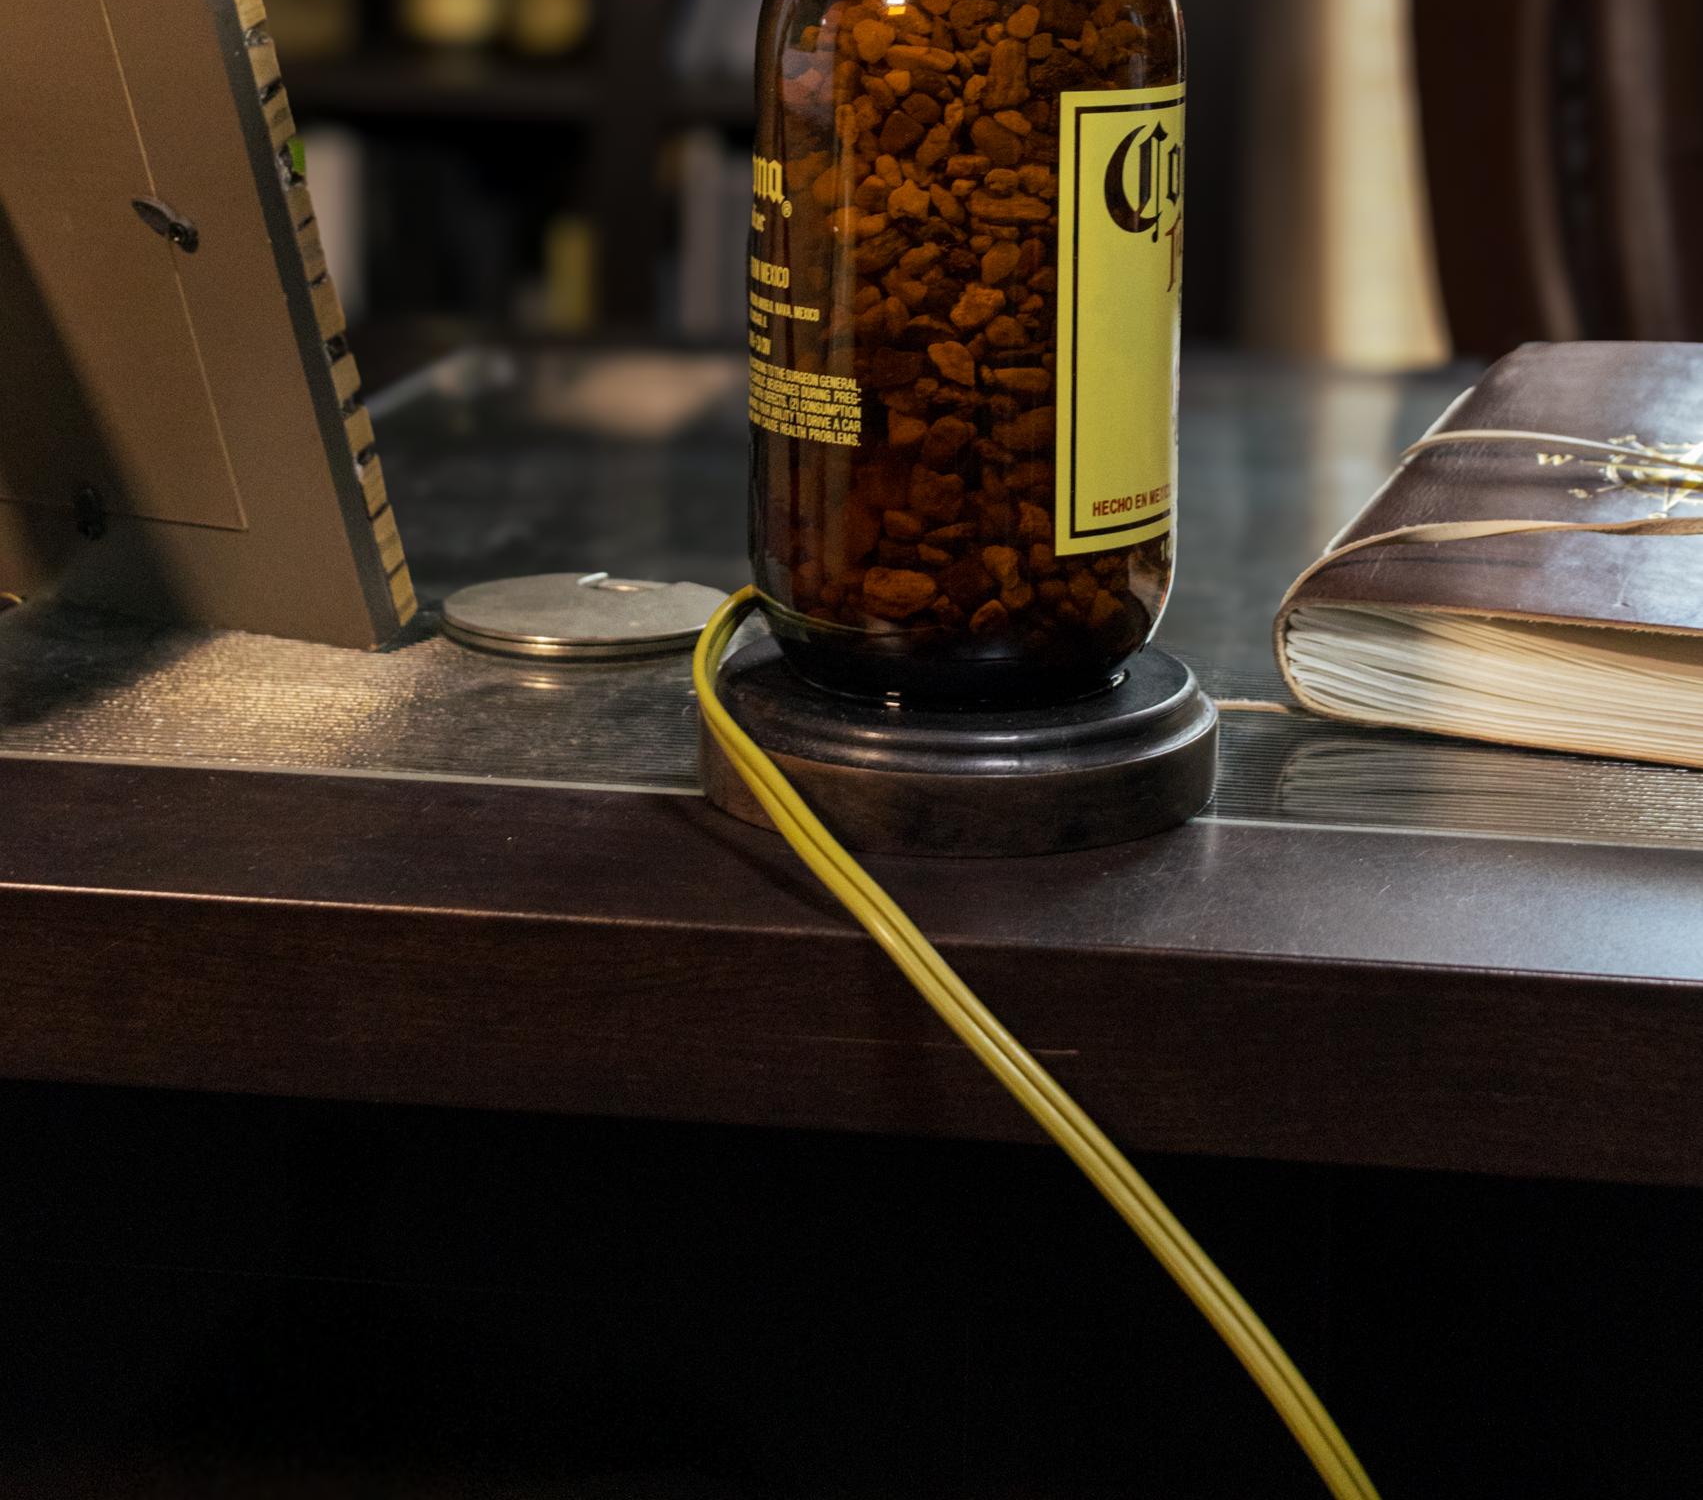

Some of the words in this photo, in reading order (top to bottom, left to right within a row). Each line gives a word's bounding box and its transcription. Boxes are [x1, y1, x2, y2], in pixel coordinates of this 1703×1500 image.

[786, 369, 819, 386] SURGEON
[820, 375, 861, 393] GENERAL,
[801, 386, 831, 403] DURING
[833, 390, 862, 405] PREG-
[800, 399, 861, 419] CONSUMPTION
[795, 411, 806, 425] TO
[806, 414, 833, 430] DRIVE
[833, 418, 840, 431] A
[841, 419, 861, 433] CAR
[779, 421, 807, 439] HEALTH
[808, 428, 861, 447] PROBLEMS.
[1092, 496, 1133, 516] HECHO
[1135, 492, 1148, 510] EN
